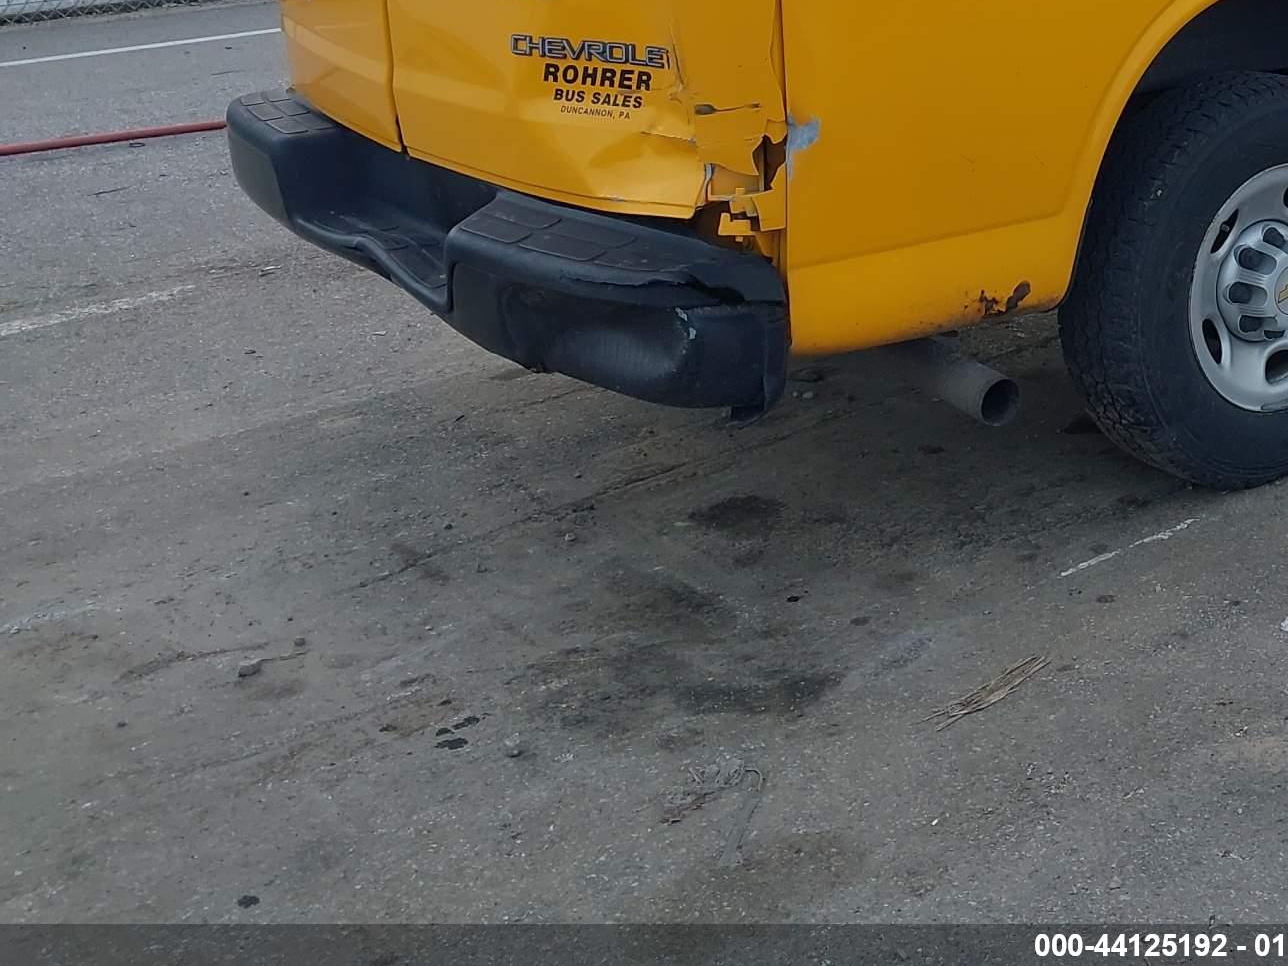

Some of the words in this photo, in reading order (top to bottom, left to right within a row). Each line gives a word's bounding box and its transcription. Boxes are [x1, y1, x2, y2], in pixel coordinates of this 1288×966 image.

[543, 63, 652, 91] ROHRER
[554, 89, 585, 103] BUS
[591, 92, 643, 109] SALES
[560, 105, 615, 119] DUNCANNON,
[618, 111, 630, 120] PA
